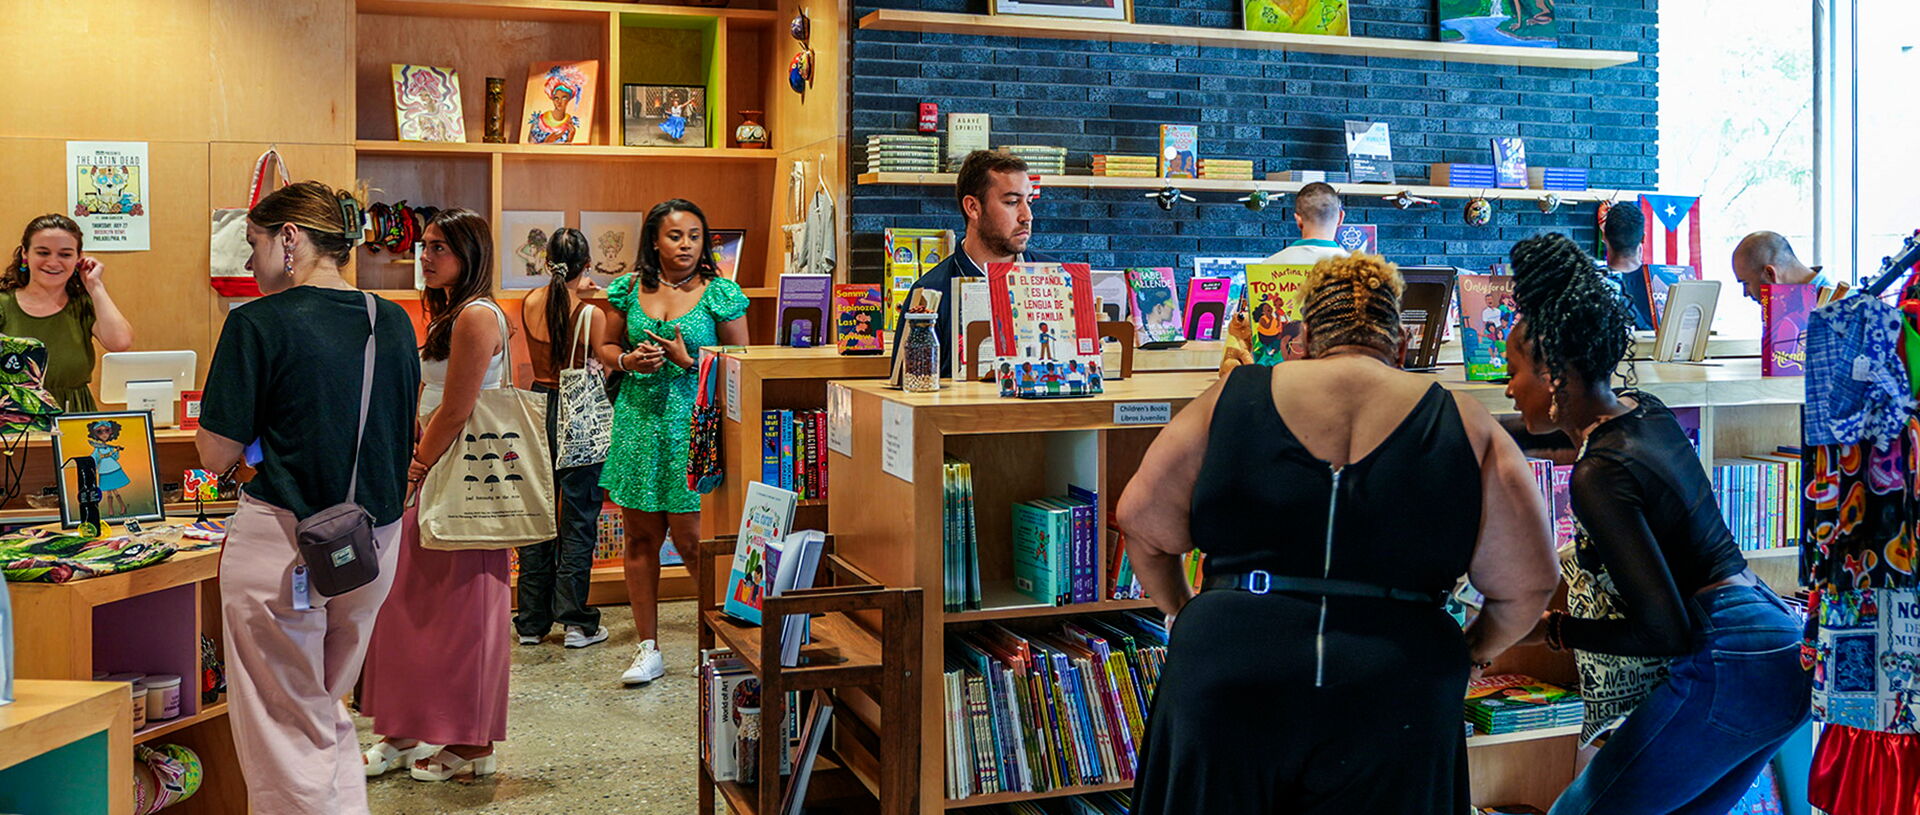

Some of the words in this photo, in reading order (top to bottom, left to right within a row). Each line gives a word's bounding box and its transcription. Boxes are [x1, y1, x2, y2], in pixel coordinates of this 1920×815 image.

[77, 156, 90, 164] THE
[94, 156, 116, 164] LATIN
[120, 156, 140, 164] DEAD
[1272, 268, 1302, 279] Martina
[1020, 276, 1029, 285] EL
[1031, 275, 1063, 285] ESPAÑOL
[1134, 280, 1172, 288] ALLENDE
[1250, 281, 1276, 294] TOO
[1280, 282, 1300, 292] MA
[1464, 279, 1486, 293] Only
[1487, 281, 1499, 293] for
[1032, 289, 1040, 297] ES
[1042, 289, 1052, 297] LA
[838, 304, 880, 312] Espinoza's
[1024, 300, 1051, 309] LENGUA
[1055, 300, 1064, 309] DE
[1027, 312, 1035, 321] MI
[1036, 312, 1064, 321] FAMILIA
[808, 429, 816, 464] HACIENDA
[1603, 669, 1626, 690] AVE
[1583, 685, 1646, 699] FAIRMOUNT
